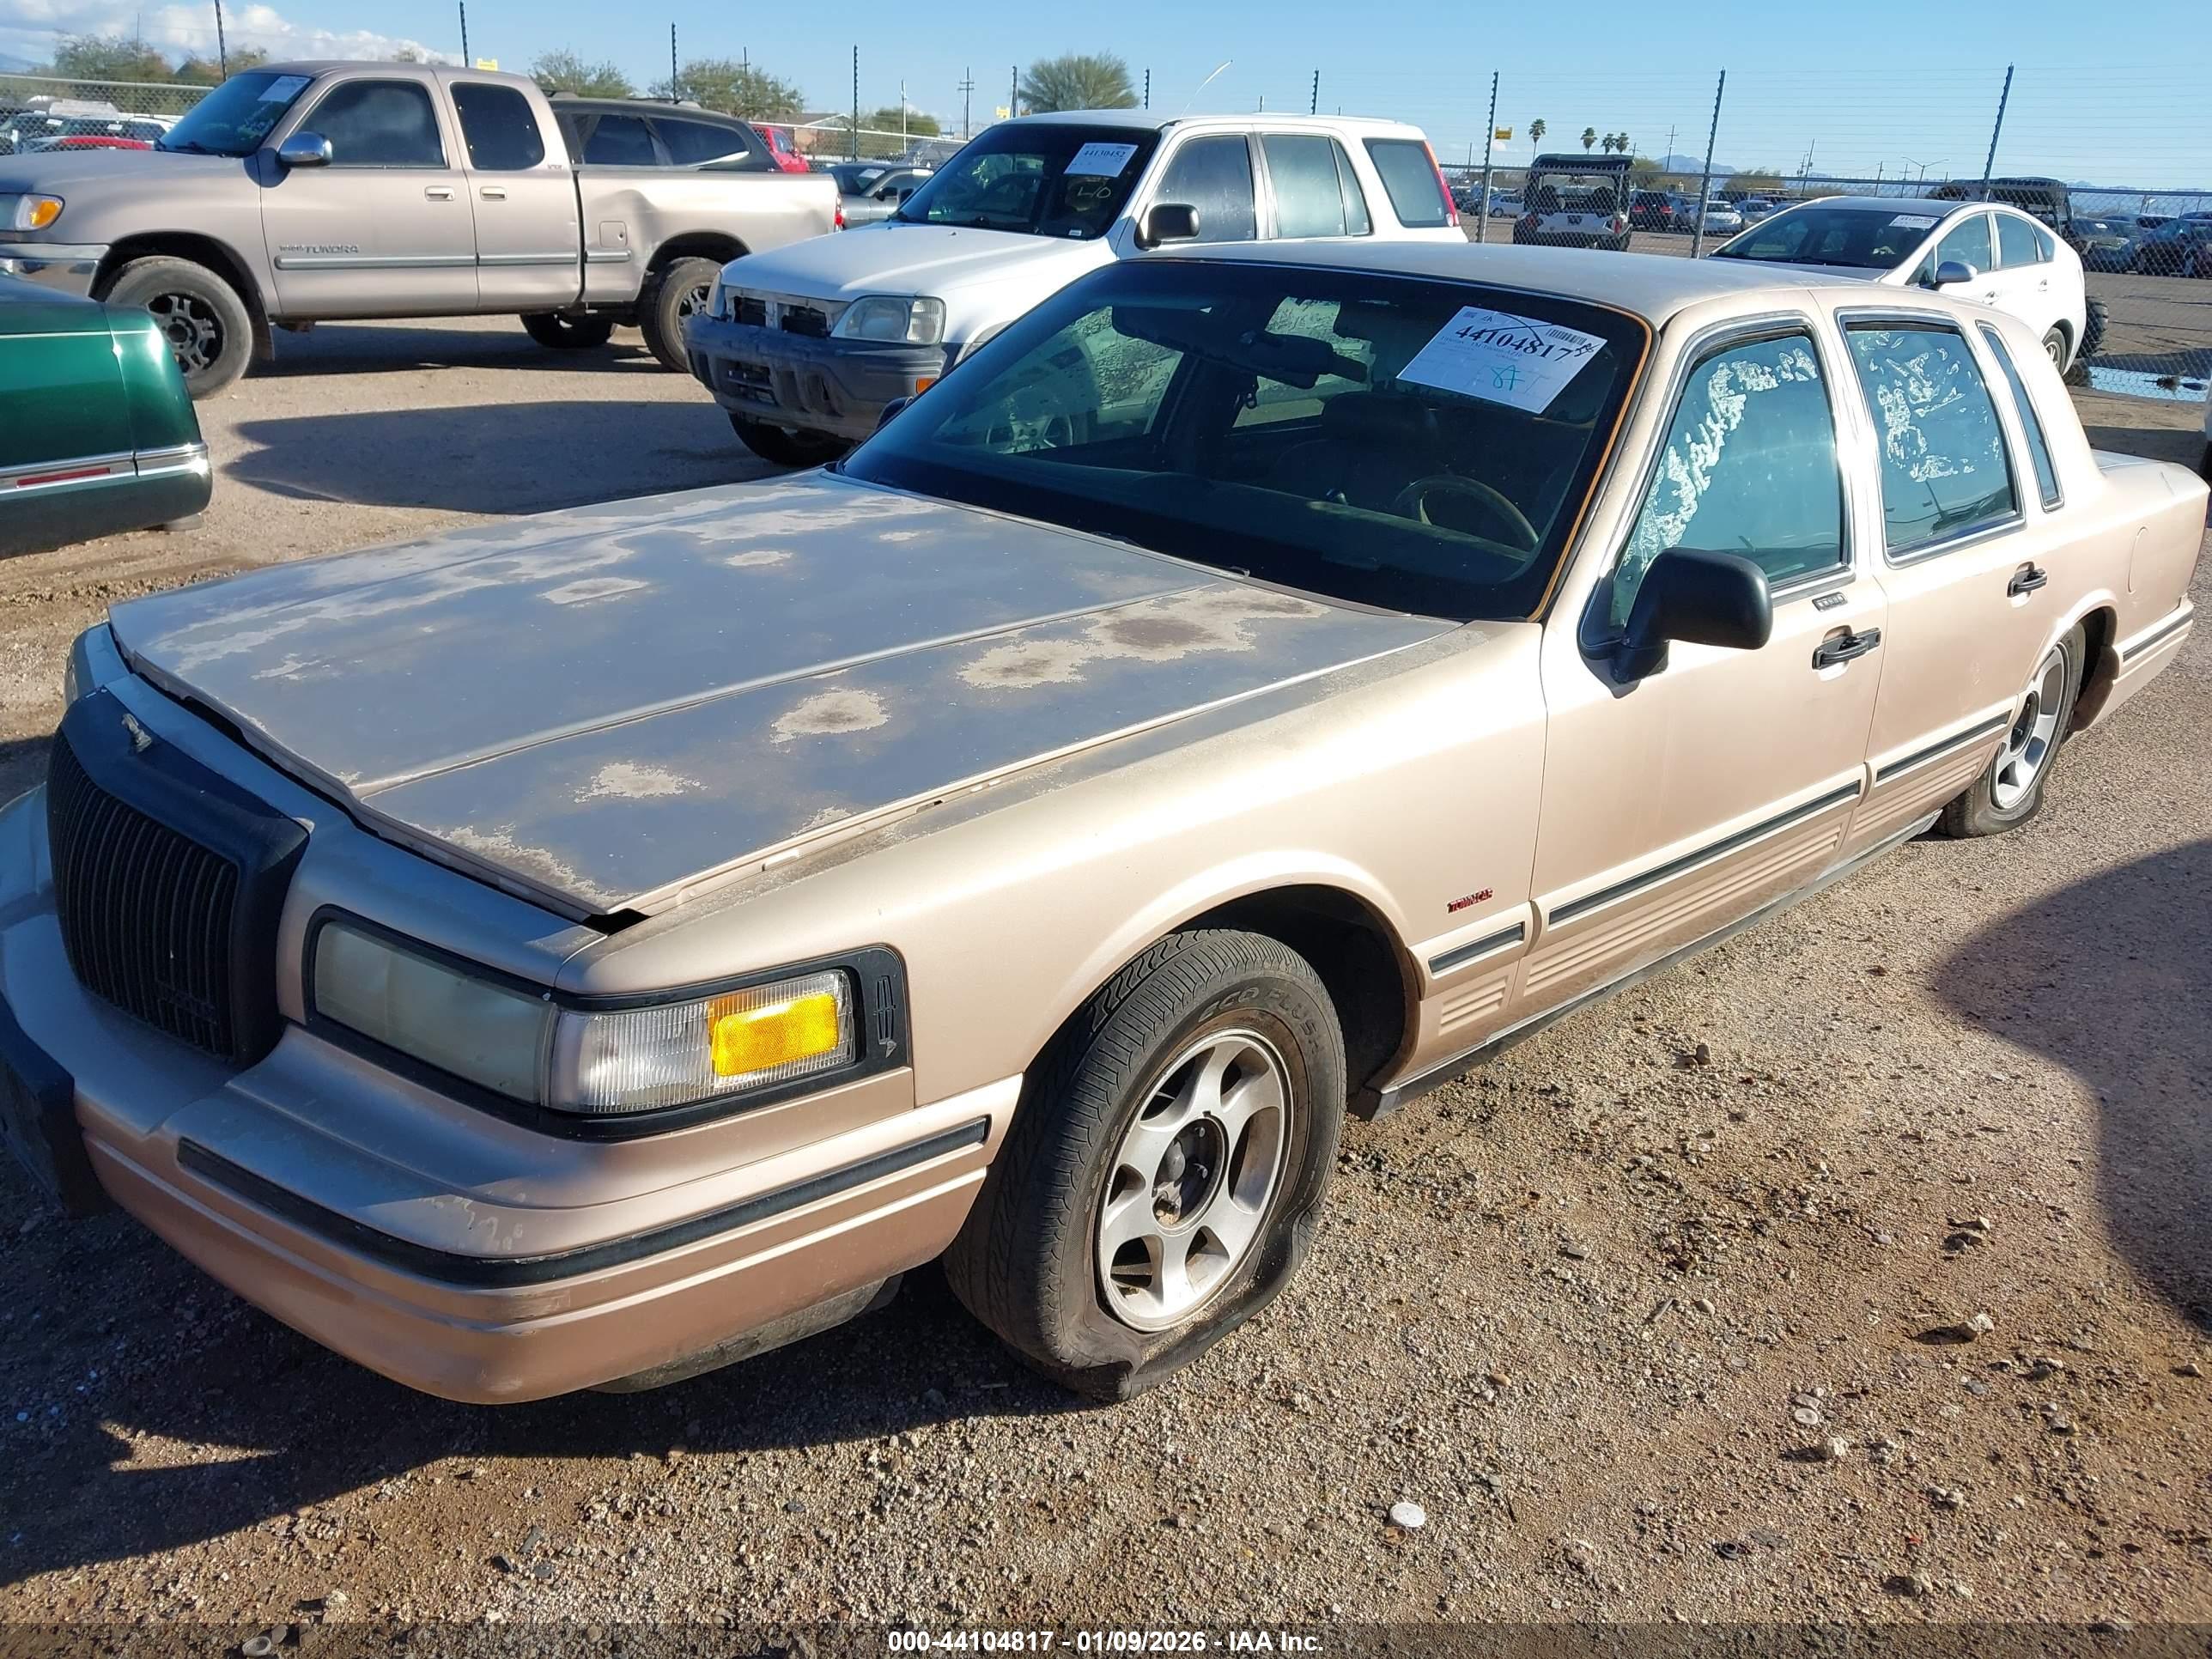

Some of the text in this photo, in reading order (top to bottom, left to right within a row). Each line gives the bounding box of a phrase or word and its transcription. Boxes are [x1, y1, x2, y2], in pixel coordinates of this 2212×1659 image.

[306, 245, 359, 254] TUNDRA
[1455, 325, 1573, 362] 44104817
[1198, 987, 1260, 1023] ECO
